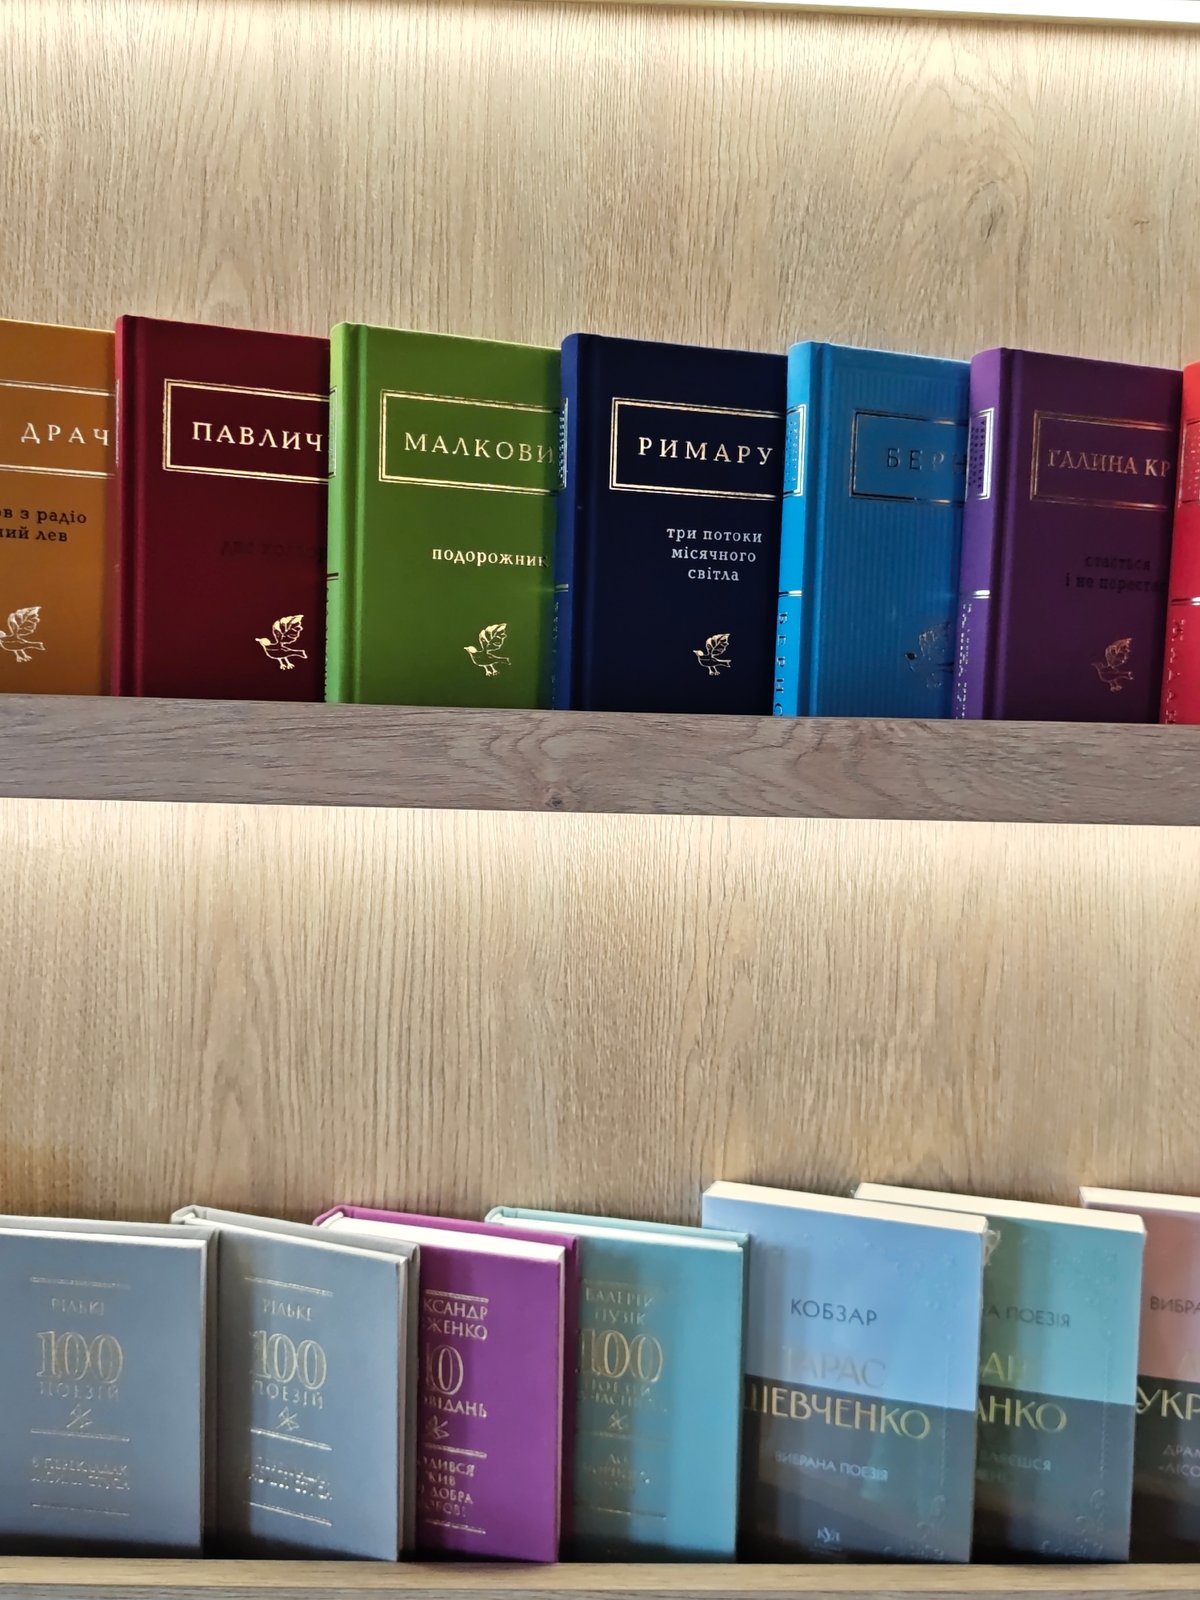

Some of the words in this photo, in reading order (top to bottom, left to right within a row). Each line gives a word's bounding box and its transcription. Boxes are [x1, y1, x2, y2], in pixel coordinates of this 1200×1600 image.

[20, 422, 110, 446] ДРАЧ
[191, 421, 323, 452] ПАВЛИЧ
[403, 431, 554, 464] МАЛКОВИ
[637, 436, 774, 465] РИМАРУ
[1047, 449, 1138, 475] ГАЛИНА
[1144, 458, 1171, 478] КР
[0, 508, 13, 519] в
[20, 509, 30, 520] з
[36, 510, 88, 526] радіо
[35, 530, 68, 542] лев
[665, 527, 698, 543] три
[702, 528, 763, 544] потоки
[431, 549, 550, 568] подорожник
[670, 546, 757, 563] місячного
[687, 566, 740, 582] світла
[790, 1298, 878, 1327] КОБЗАР
[1006, 1306, 1071, 1330] ПОЕЗІЯ
[36, 1330, 124, 1384] 100
[248, 1329, 328, 1391] 100
[576, 1328, 664, 1383] 100
